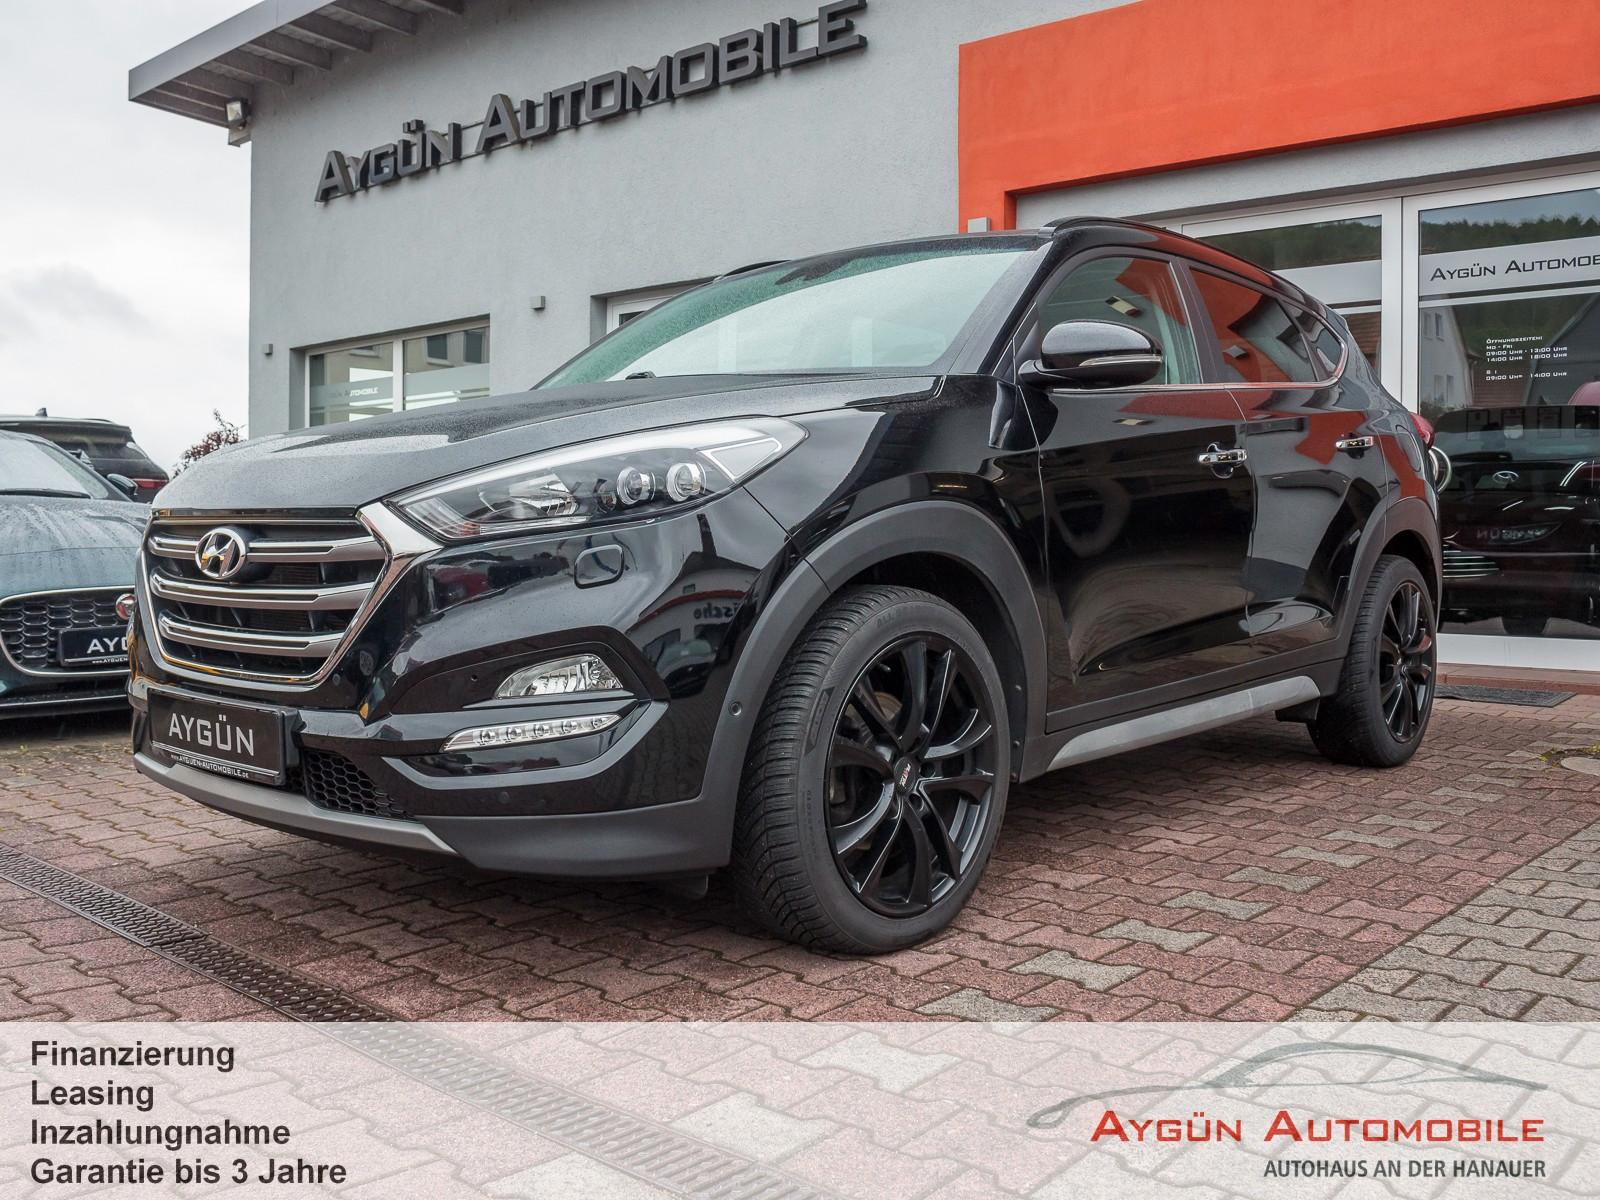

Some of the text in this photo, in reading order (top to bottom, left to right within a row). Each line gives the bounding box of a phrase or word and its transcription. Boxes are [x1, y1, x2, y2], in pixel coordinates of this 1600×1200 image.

[315, 0, 867, 202] AYGÜN AUTOMOBILE
[1430, 263, 1496, 281] AYGÜN
[168, 712, 255, 757] AYGÜN
